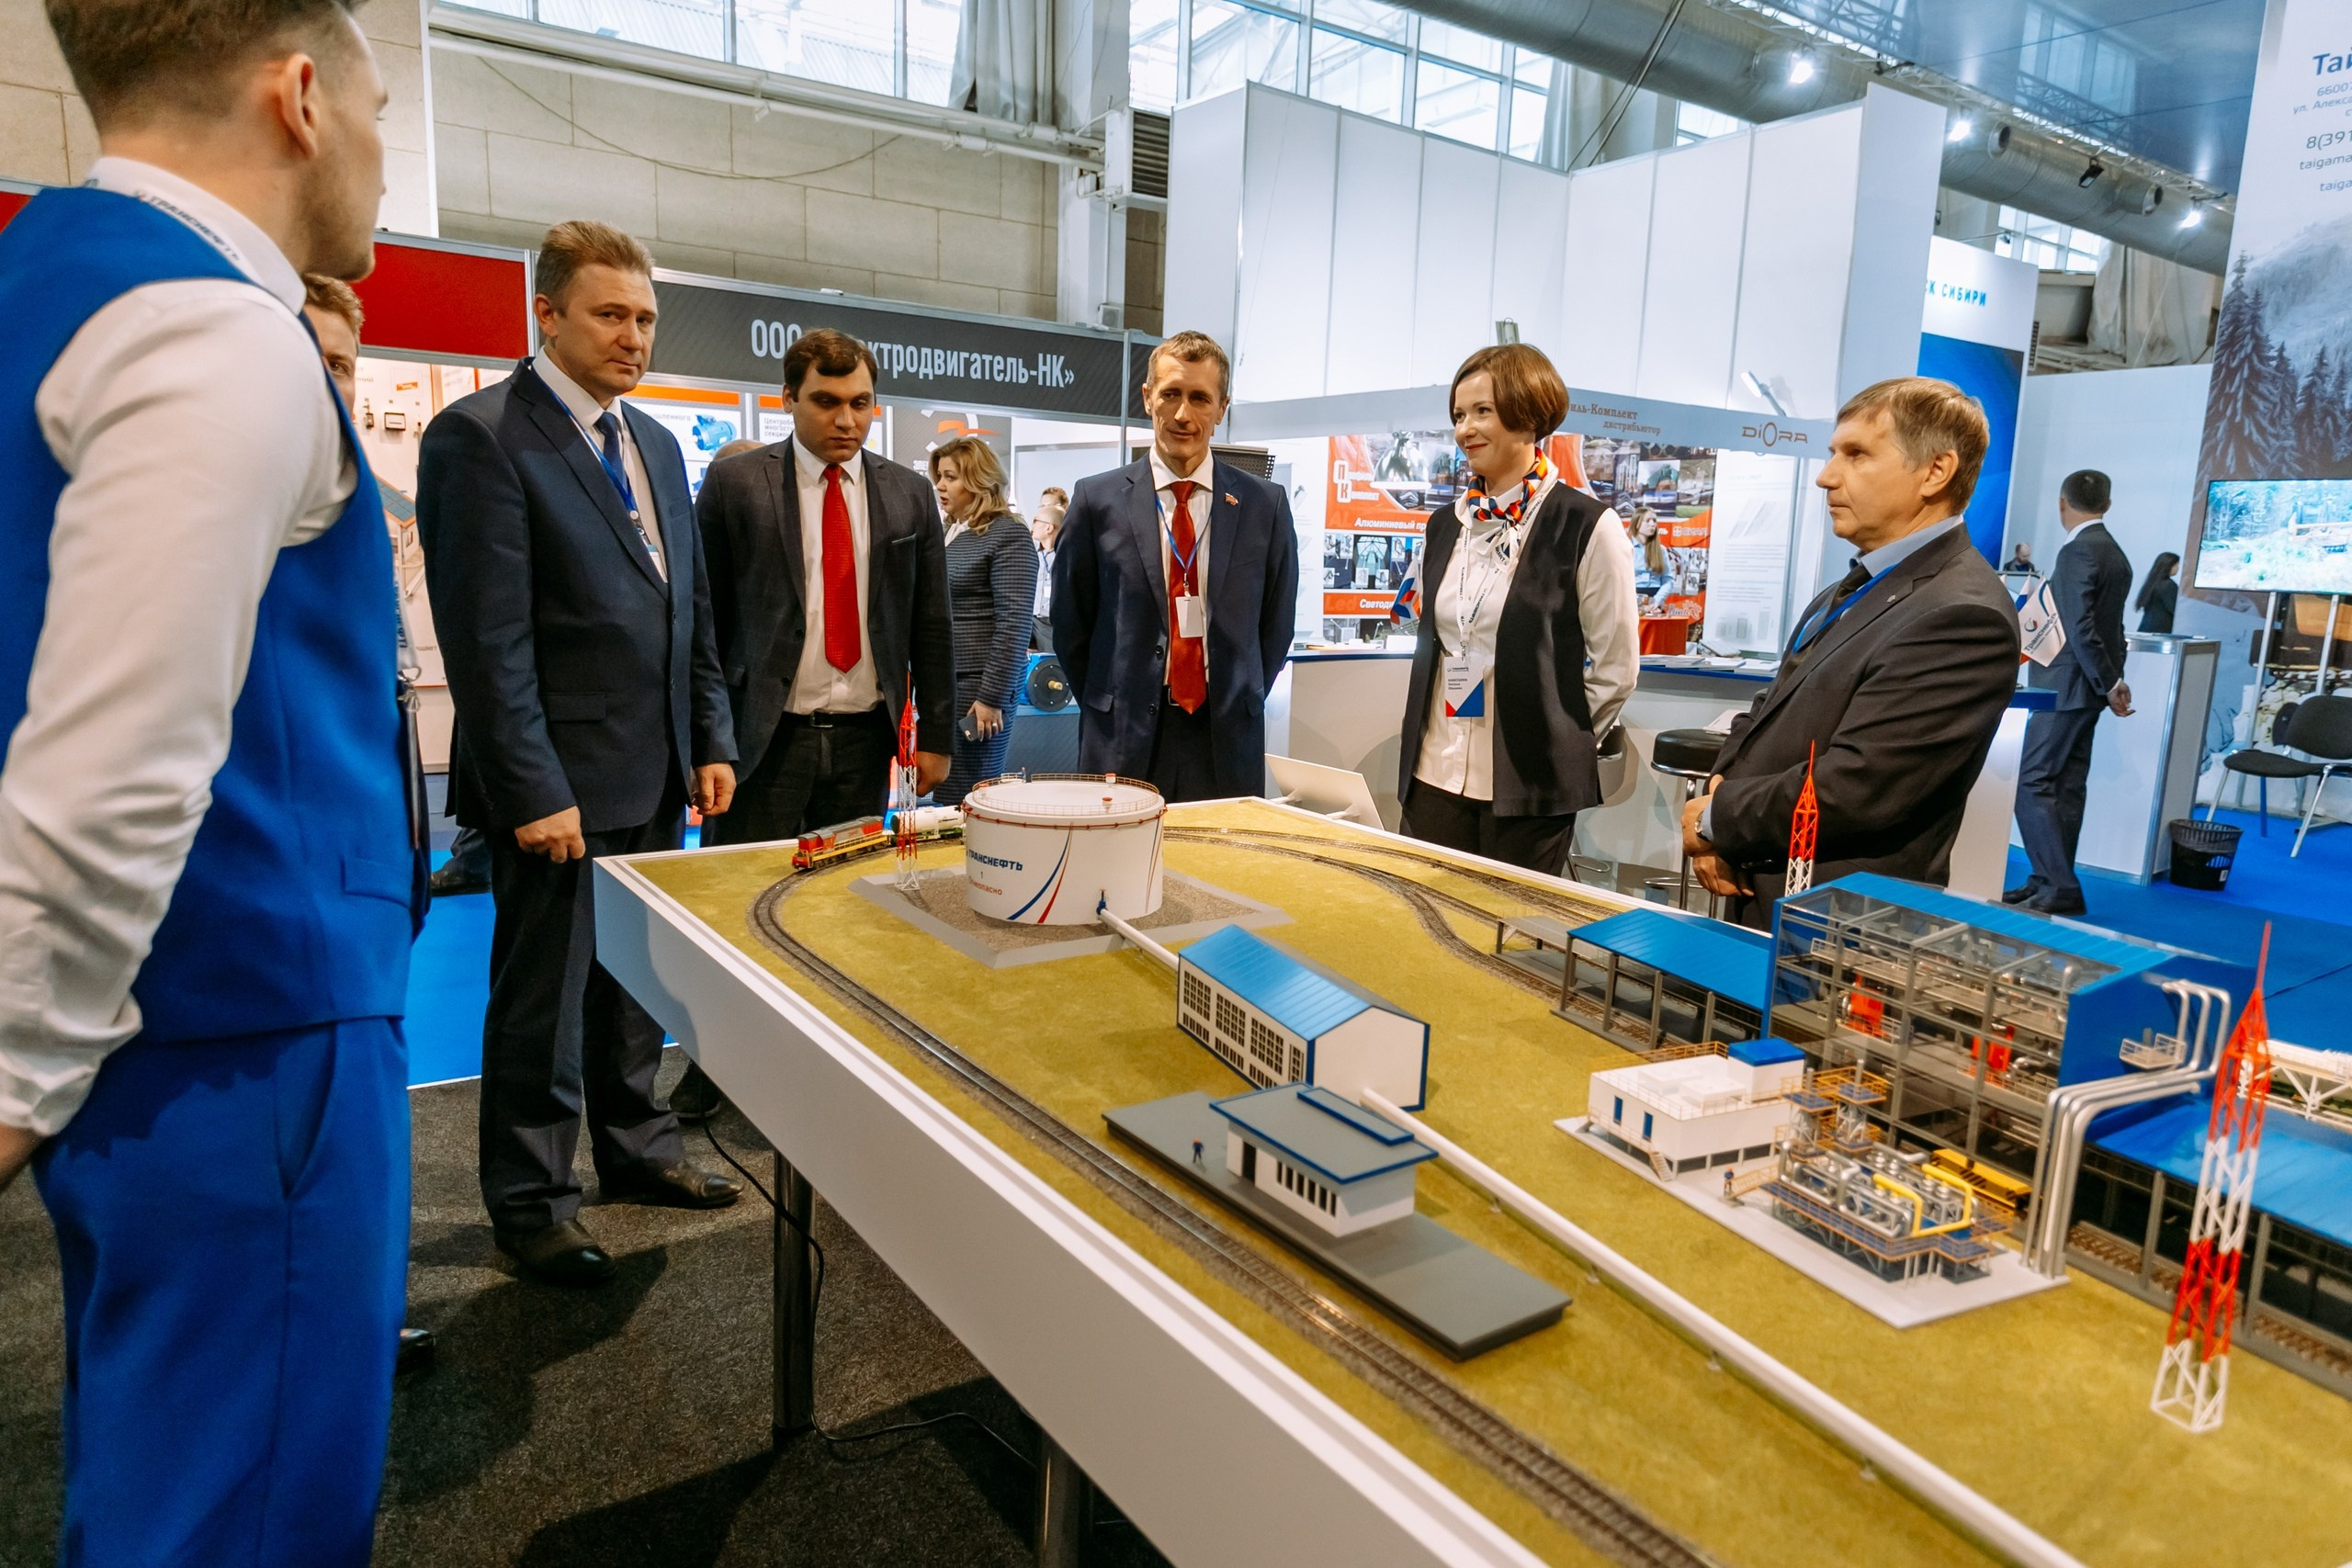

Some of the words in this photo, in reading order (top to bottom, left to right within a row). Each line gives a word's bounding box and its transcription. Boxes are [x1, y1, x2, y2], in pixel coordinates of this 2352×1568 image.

[1941, 283, 1987, 307] СИБИРИ
[751, 319, 803, 359] ООО
[865, 341, 1075, 388] ктродвигатель-НК»
[968, 848, 1023, 871] ТРАНСНЕФТЬ
